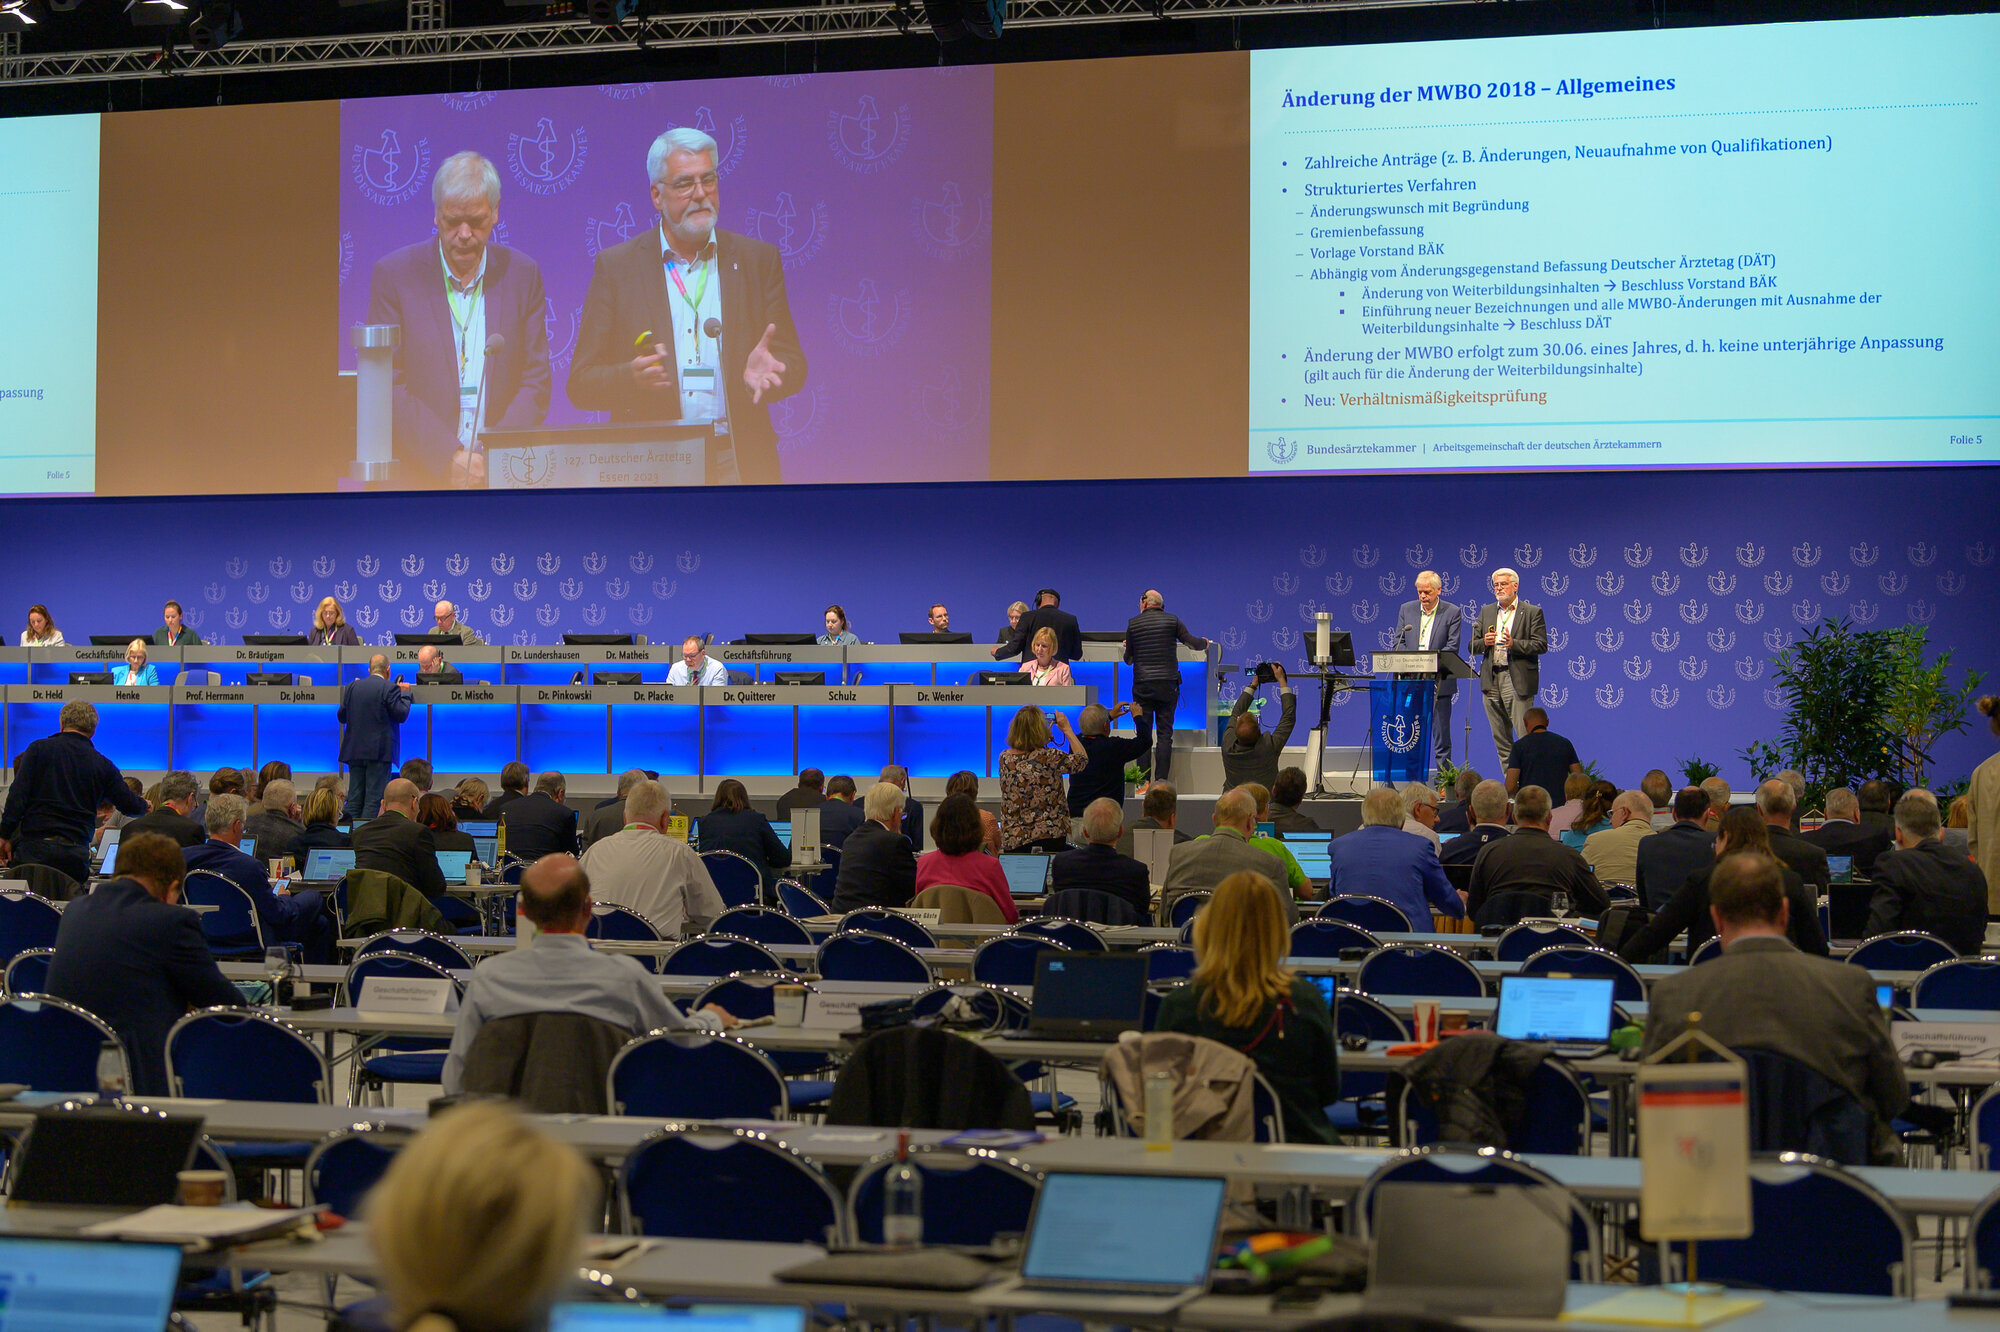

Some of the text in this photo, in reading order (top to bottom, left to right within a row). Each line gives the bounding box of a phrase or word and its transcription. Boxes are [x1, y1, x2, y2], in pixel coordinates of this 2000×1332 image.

[1282, 88, 1375, 109] Änderung
[1380, 87, 1412, 103] der
[1418, 83, 1481, 102] MWBO
[1487, 81, 1535, 99] 2018
[1556, 75, 1675, 98] Allgemeines
[1305, 135, 1832, 170] Zahlreiche Anträge (z. B. Änderungen, Neuaufnahme von Qualifikationen)
[1305, 177, 1476, 196] Strukturiertes Verfahren
[1310, 198, 1529, 219] Änderungswunsch mit Begründung
[1311, 224, 1424, 238] Gremienbefassung
[1310, 241, 1444, 260] Vorlage Vorstand BÄK
[1310, 252, 1775, 282] Abhängig vom Änderungsgegenstand Befassung Deutscher Ärztetag (DÄT)
[1362, 273, 1777, 301] Änderung von Weiterbildungsinhalten Beschluss Vorstand BÄK
[1363, 291, 1882, 319] Einführung neuer Bezeichnungen und alle MWBO-Änderungen mit Ausnahme der
[1362, 314, 1612, 336] Weiterbildungsinhalte Beschluss DÄT
[1304, 335, 1944, 365] Änderung der MWBO erfolgt zum 30.06. eines Jahres, d. h. keine unterjährige Anpassung
[1305, 361, 1642, 384] (gilt auch für die Änderung der Weiterbildungsinhalte)
[1304, 387, 1547, 408] Neu: Verhältnismäßigkeitsprüfung
[1950, 434, 1982, 445] Folie 5
[1307, 442, 1417, 455] Bundesärztekammer
[1433, 441, 1525, 454] Arbeitsgemeinschaft
[1527, 441, 1542, 451] der
[1544, 440, 1591, 450] deutschen
[1593, 439, 1662, 450] Ärztekammern
[589, 452, 643, 465] Deutscher
[647, 449, 692, 465] Ärztetag
[47, 470, 70, 480] Folie 5
[600, 471, 631, 483] Essen
[75, 650, 125, 660] Geschäftsführ
[237, 650, 284, 661] Dr. Bräutigam
[397, 651, 406, 659] Dr.
[512, 650, 579, 659] Dr. Lundershausen
[606, 650, 649, 659] Dr. Matheis
[723, 650, 792, 662] Geschäftsführung
[33, 690, 63, 700] Dr. Held
[116, 690, 140, 700] Henke
[186, 690, 244, 701] Prof. Herrmann
[280, 691, 315, 703] Dr. Johna
[452, 690, 494, 700] Dr. Mischo
[539, 690, 591, 700] Dr. Pinkowski
[634, 691, 673, 701] Dr. Placke
[724, 691, 775, 703] Dr. Quitterer
[829, 690, 856, 701] Schulz
[918, 691, 964, 701] Dr. Wenker
